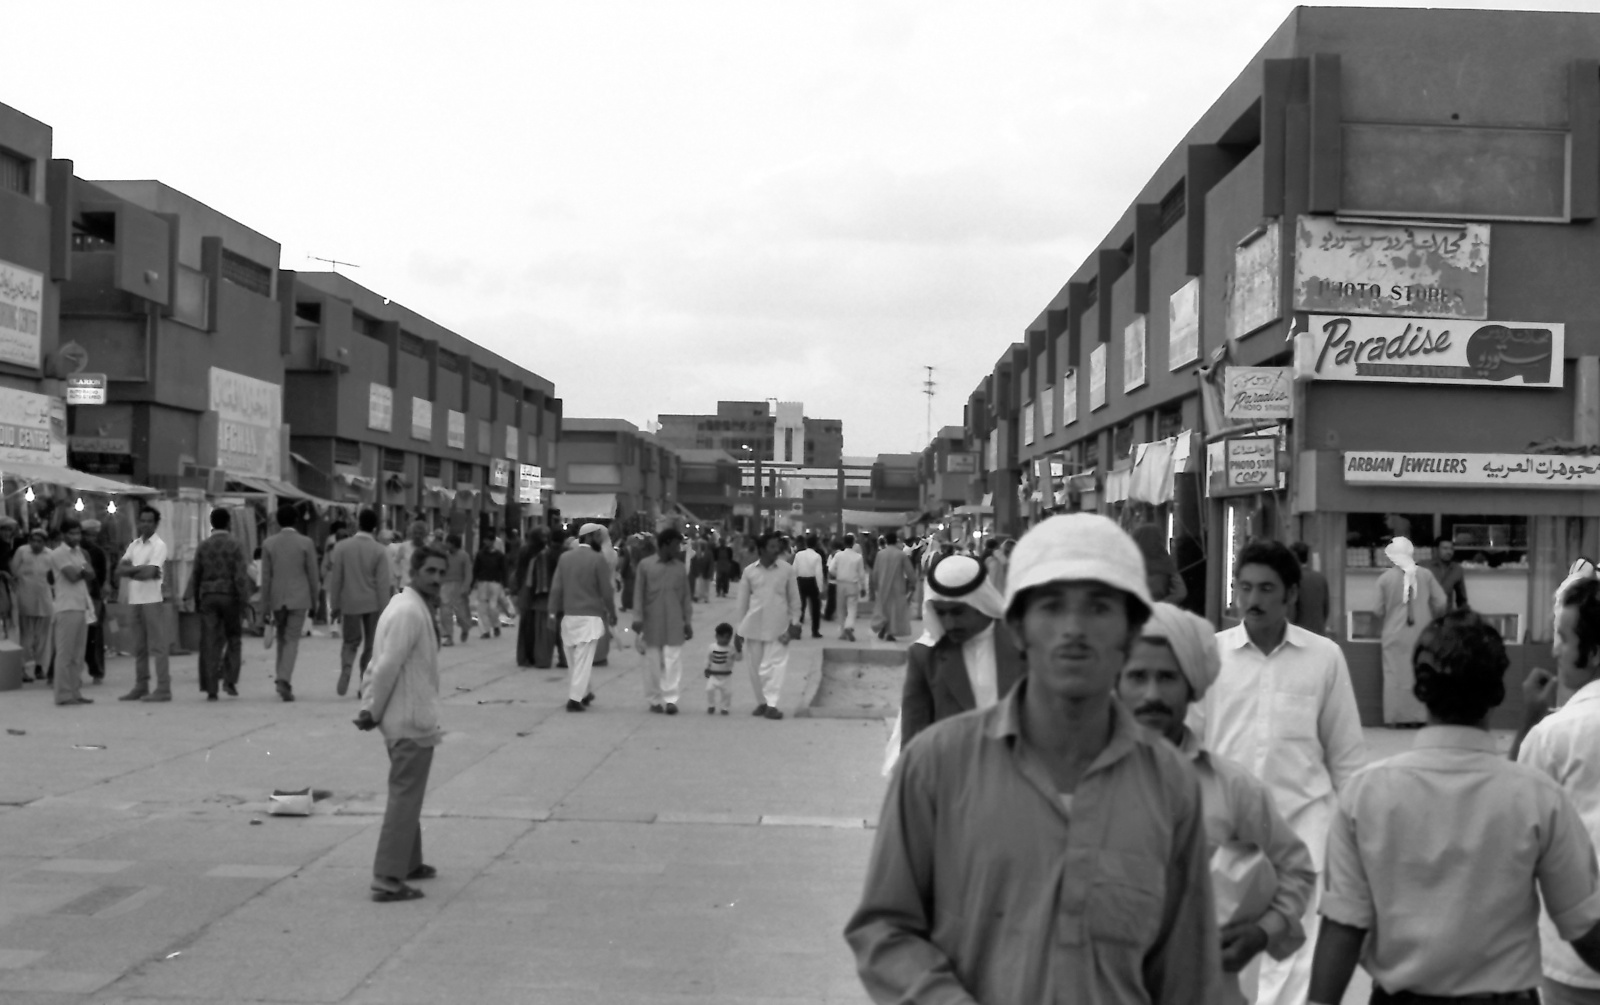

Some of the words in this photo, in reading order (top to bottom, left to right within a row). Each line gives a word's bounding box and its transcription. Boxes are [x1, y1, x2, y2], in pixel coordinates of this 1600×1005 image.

[1318, 281, 1381, 300] PHOTO
[1315, 318, 1453, 373] Paradise
[1229, 459, 1256, 469] PHOTO
[1347, 457, 1394, 472] ARBIAN
[1393, 455, 1467, 478] JEWELLERS
[1235, 470, 1268, 485] COPY
